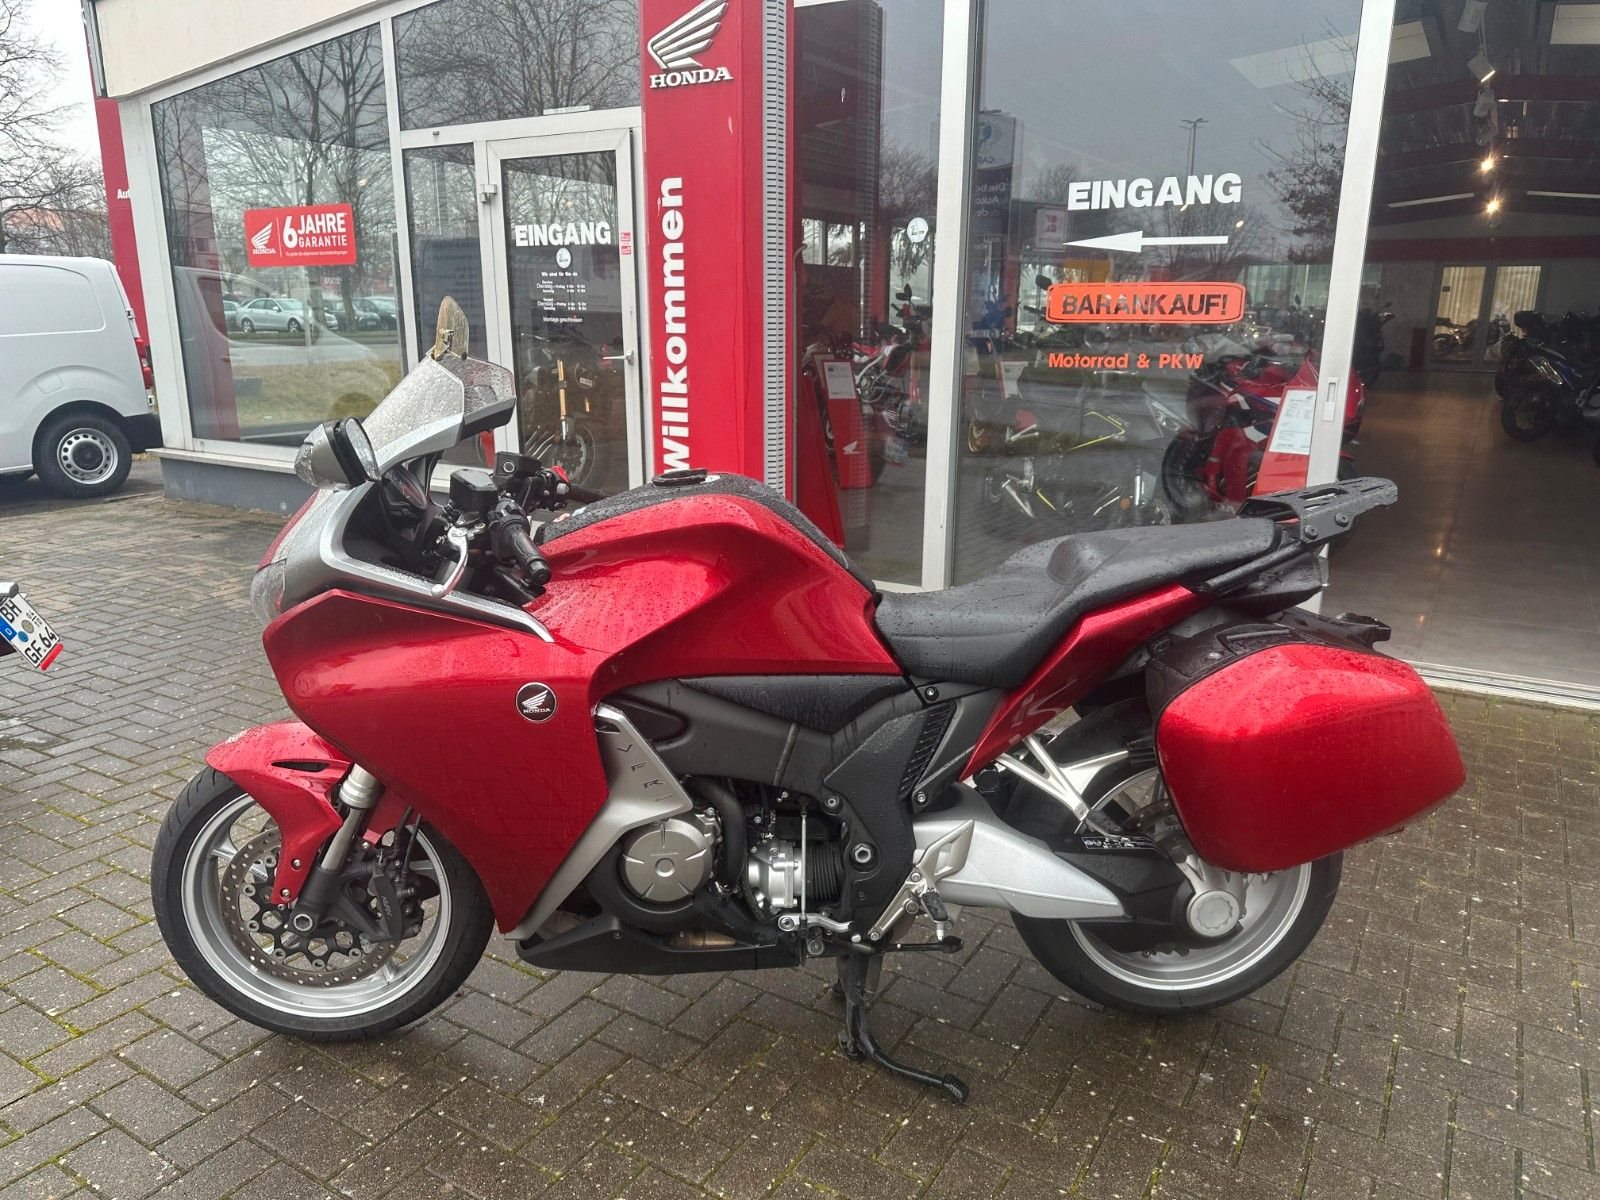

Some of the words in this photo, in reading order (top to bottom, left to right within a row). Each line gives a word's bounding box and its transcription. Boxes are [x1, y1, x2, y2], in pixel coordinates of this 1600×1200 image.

[649, 66, 733, 89] HONDA
[1067, 172, 1242, 211] EINGANG
[282, 215, 298, 249] 6
[297, 212, 347, 235] JAHRE
[298, 234, 348, 249] GARANTIE
[514, 221, 612, 247] EINGANG
[252, 247, 277, 255] HONDA
[1061, 293, 1229, 316] BARANKAUF!
[1048, 352, 1129, 369] Motorrad
[1136, 353, 1150, 369] &
[1158, 353, 1205, 370] PKW
